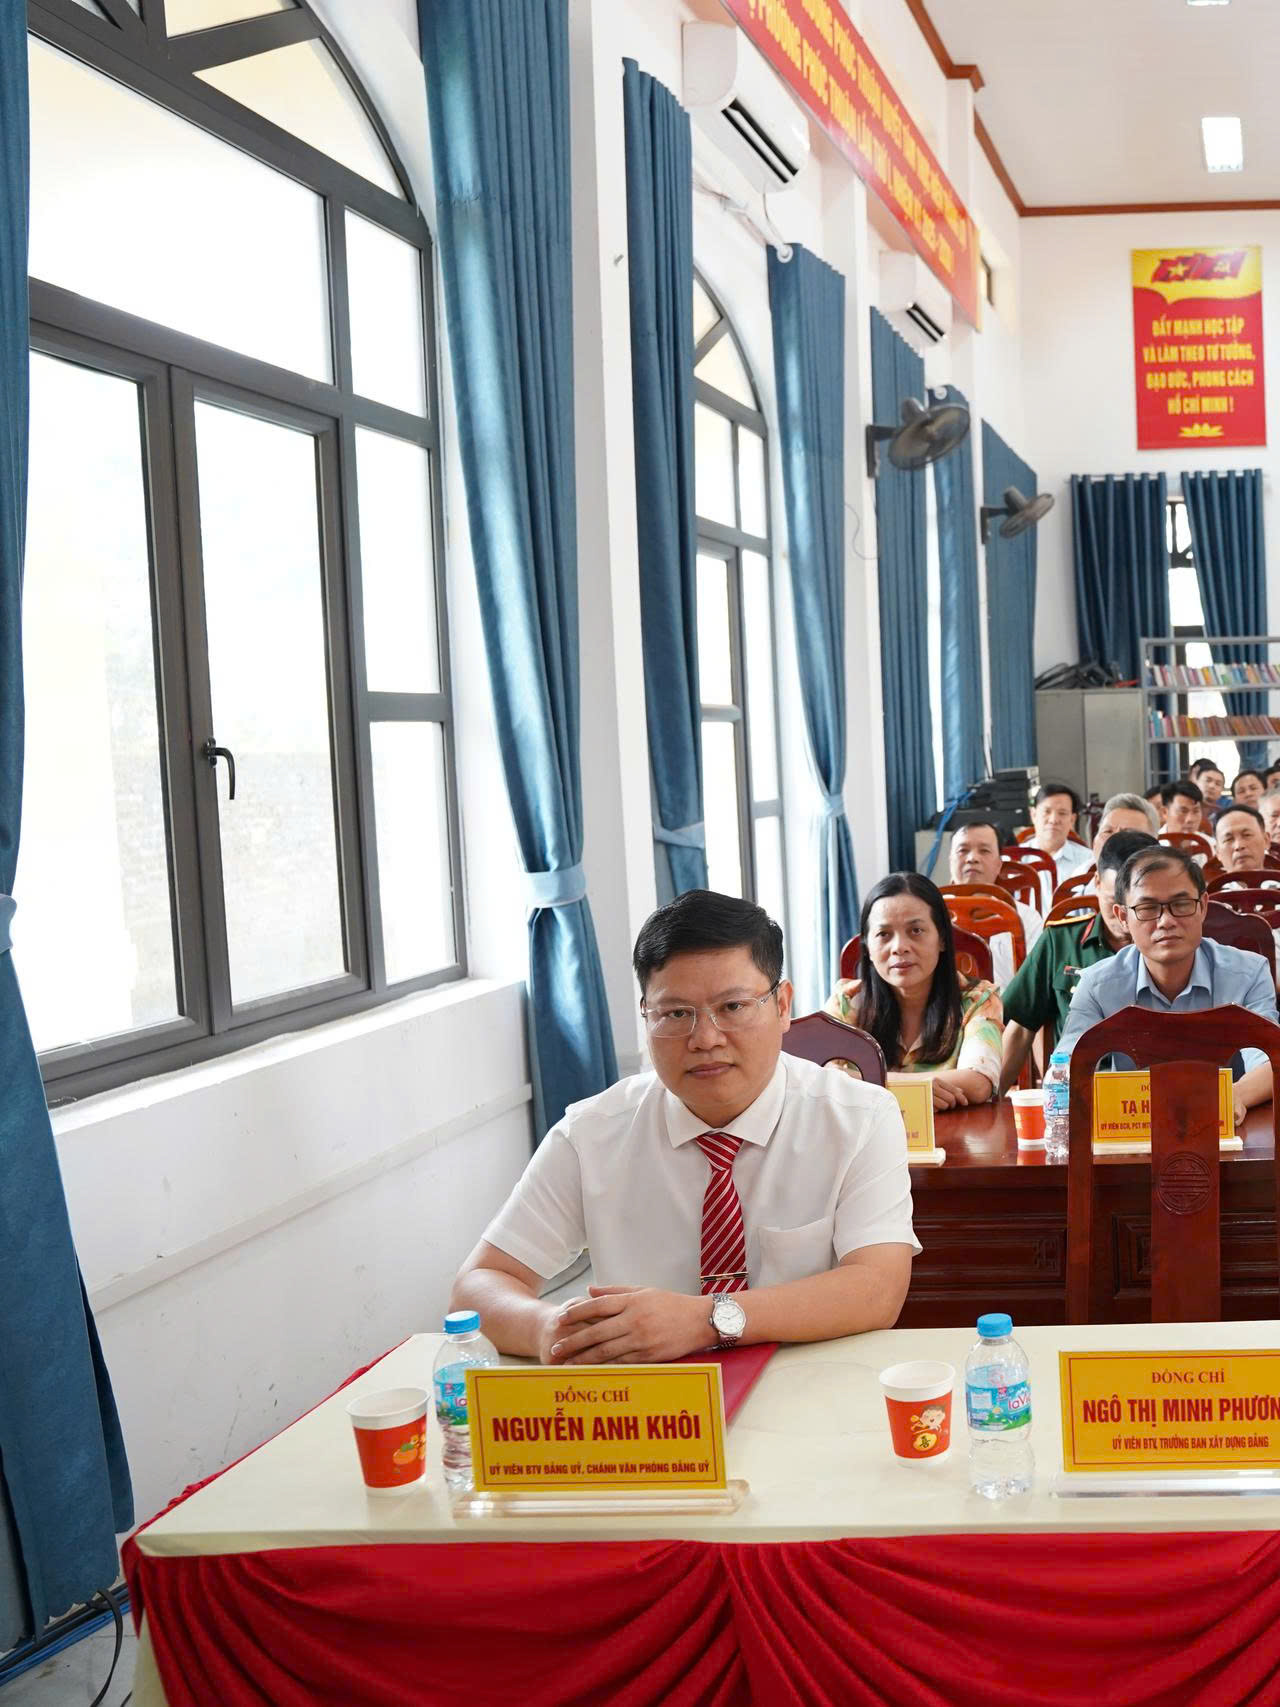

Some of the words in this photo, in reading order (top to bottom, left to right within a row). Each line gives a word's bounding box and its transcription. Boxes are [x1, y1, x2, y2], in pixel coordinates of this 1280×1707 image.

[1181, 345, 1204, 362] THEO
[1192, 370, 1226, 387] PHONG
[1227, 367, 1254, 387] CÁCH
[1201, 396, 1228, 413] MINH
[1121, 1100, 1137, 1117] TẠ
[1151, 1368, 1194, 1384] ĐỒNG
[1198, 1368, 1225, 1383] CHÍ
[554, 1386, 598, 1403] ĐỒNG
[602, 1386, 629, 1402] CHÍ
[1082, 1394, 1122, 1424] NGÔ
[1129, 1399, 1157, 1427] THỊ
[1163, 1398, 1213, 1423] MINH
[491, 1407, 585, 1442] NGUYỄN
[592, 1416, 640, 1440] ANH
[647, 1410, 701, 1440] KHÔI
[1124, 1436, 1141, 1449] VIÊN
[1191, 1437, 1207, 1448] BAN
[1209, 1434, 1223, 1448] XÂY
[1225, 1436, 1246, 1450] DỰNG
[1248, 1433, 1268, 1448] ĐẢNG
[504, 1463, 524, 1475] VIÊN
[526, 1464, 542, 1475] BTV
[544, 1460, 568, 1475] ĐẢNG
[587, 1461, 617, 1474] CHÁNH
[619, 1461, 637, 1474] VĂN
[639, 1460, 669, 1473] PHÒNG
[672, 1459, 696, 1473] ĐẢNG
